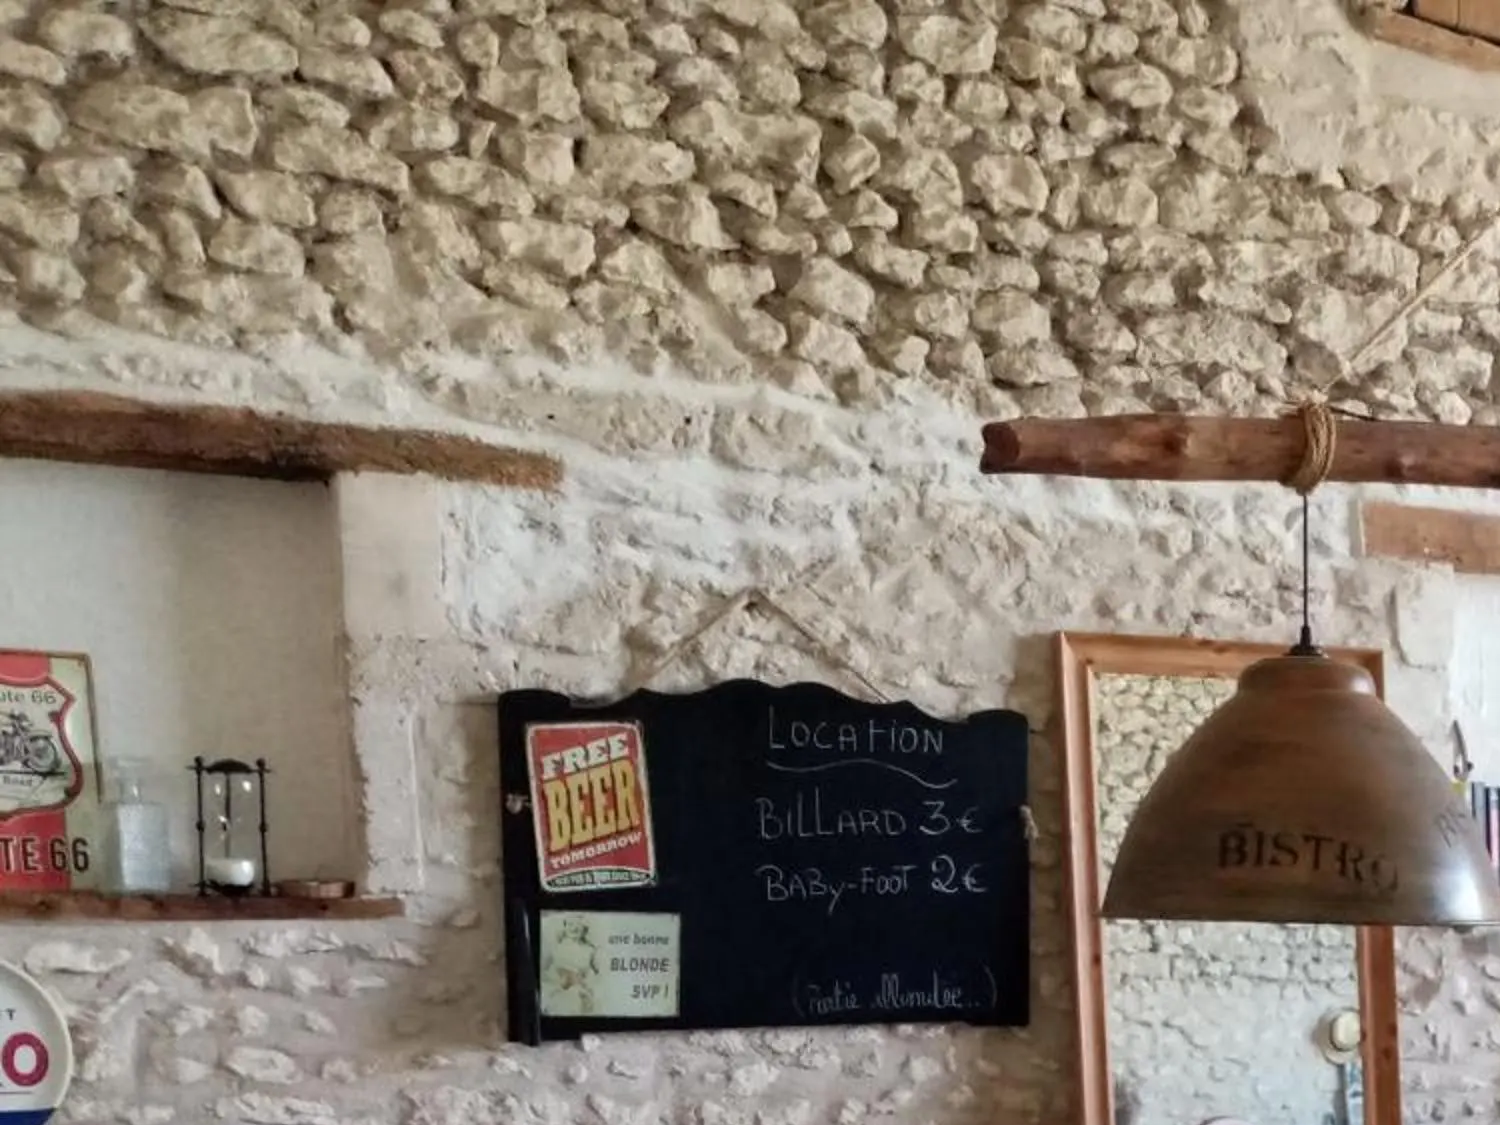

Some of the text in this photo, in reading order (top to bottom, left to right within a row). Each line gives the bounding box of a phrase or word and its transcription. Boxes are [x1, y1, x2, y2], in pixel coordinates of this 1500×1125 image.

[542, 733, 629, 780] FREE
[543, 759, 641, 852] BEER
[51, 837, 89, 872] 66
[550, 832, 642, 869] TOMORROW
[1218, 826, 1399, 893] BISTRO
[610, 957, 669, 973] BLONDE
